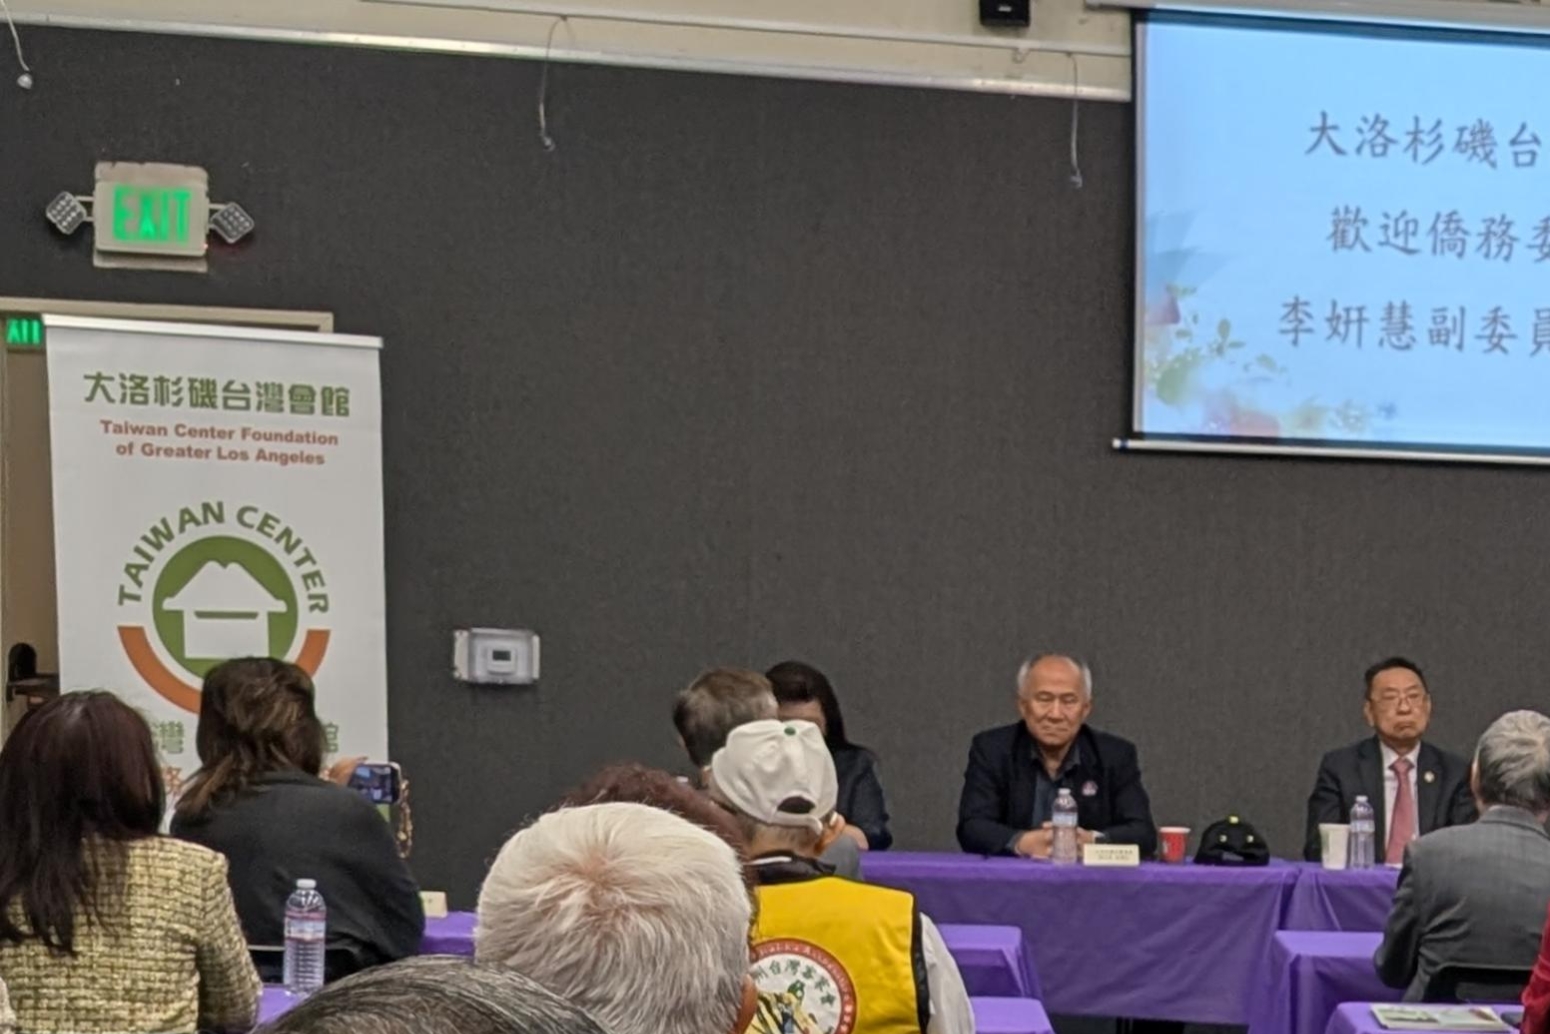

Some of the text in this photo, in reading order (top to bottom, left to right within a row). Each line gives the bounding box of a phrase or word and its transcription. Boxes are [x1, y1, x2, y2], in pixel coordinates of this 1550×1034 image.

[112, 184, 192, 244] EXIT
[83, 371, 350, 417] 大洛杉磯台灣會館
[100, 419, 338, 446] Taiwan Center Foundation
[116, 442, 325, 467] of Greater Los Angeles
[118, 500, 330, 614] TAIWAN CENTER
